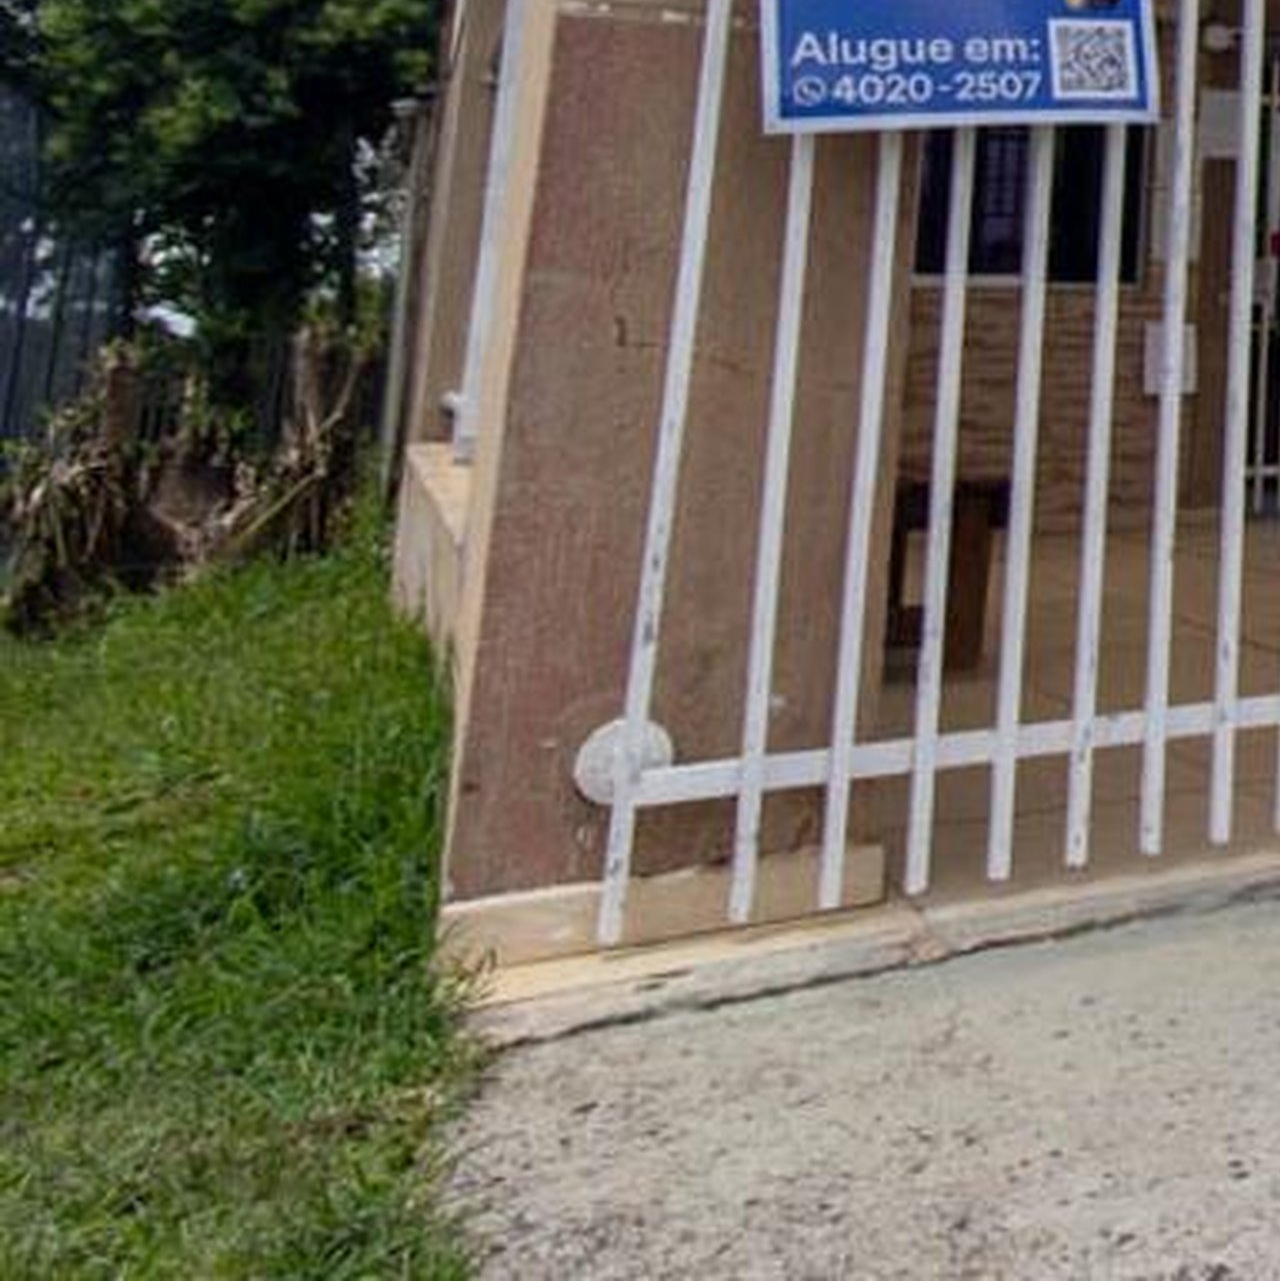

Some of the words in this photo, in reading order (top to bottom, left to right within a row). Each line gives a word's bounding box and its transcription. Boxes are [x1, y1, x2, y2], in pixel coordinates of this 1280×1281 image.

[791, 31, 955, 72] Alugue
[963, 37, 1042, 64] em:
[832, 70, 1043, 104] 4020-2507
